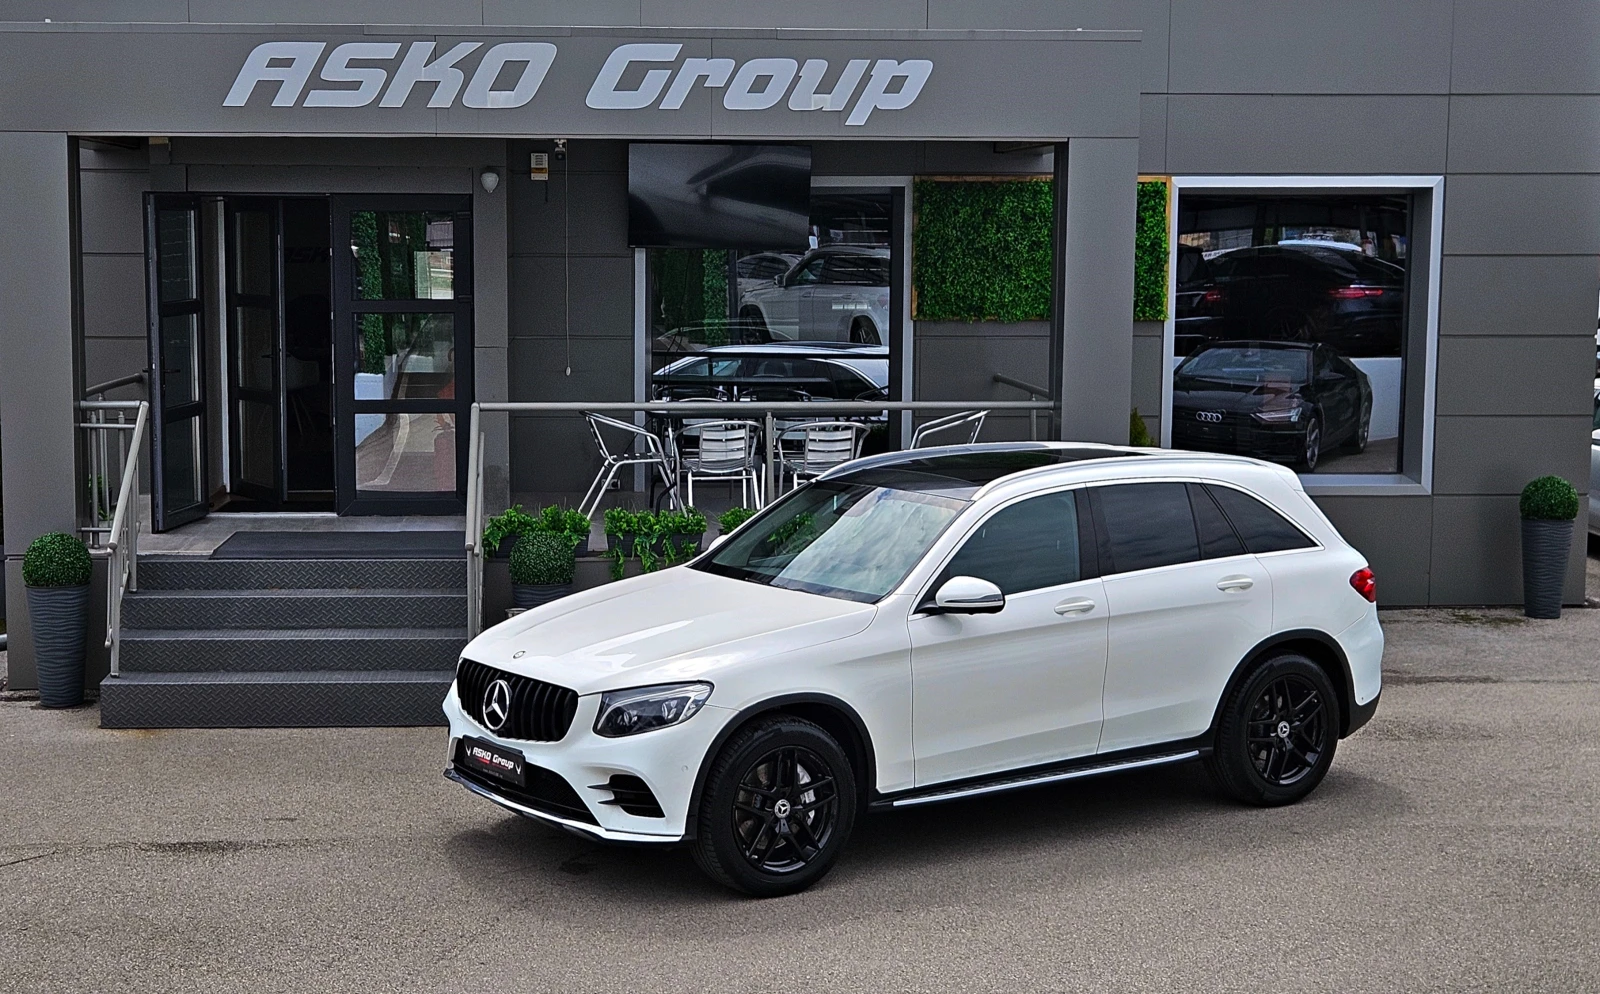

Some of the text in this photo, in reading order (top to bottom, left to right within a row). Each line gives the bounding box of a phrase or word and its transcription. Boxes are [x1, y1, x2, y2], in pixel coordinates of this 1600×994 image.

[222, 41, 934, 126] ASKO Group
[472, 747, 514, 770] ASKO Group
